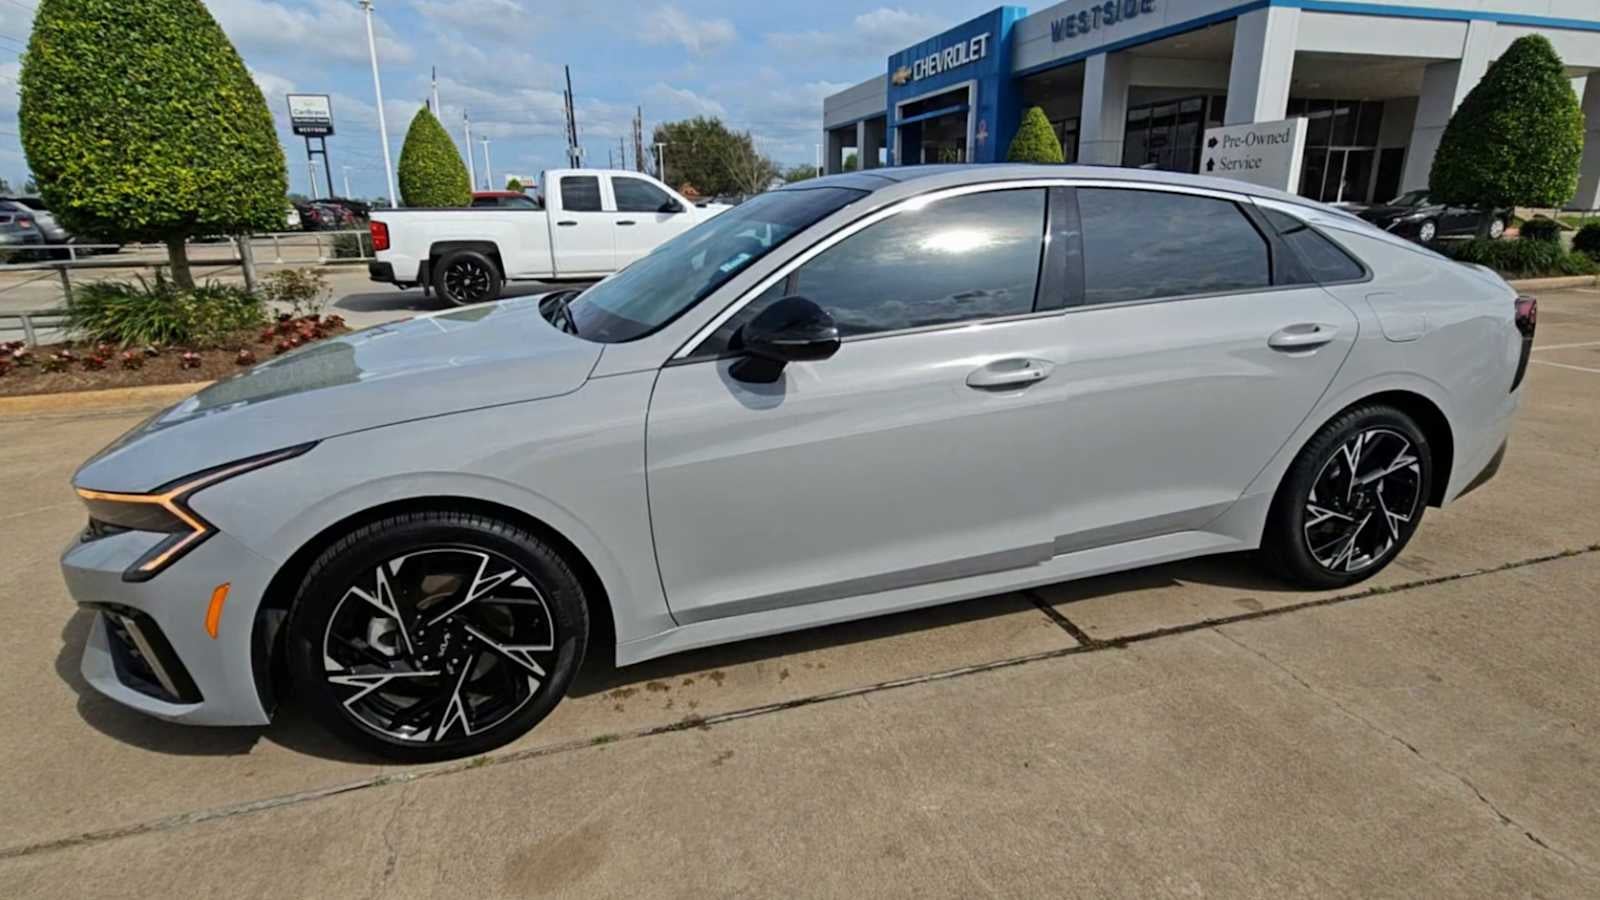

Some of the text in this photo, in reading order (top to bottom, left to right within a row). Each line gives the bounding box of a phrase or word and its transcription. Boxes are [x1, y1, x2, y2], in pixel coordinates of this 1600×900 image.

[1051, 0, 1154, 42] WESTSIDE
[912, 32, 991, 81] CHEVROLET
[1222, 128, 1290, 149] Pre-Owned
[1219, 156, 1262, 170] Service
